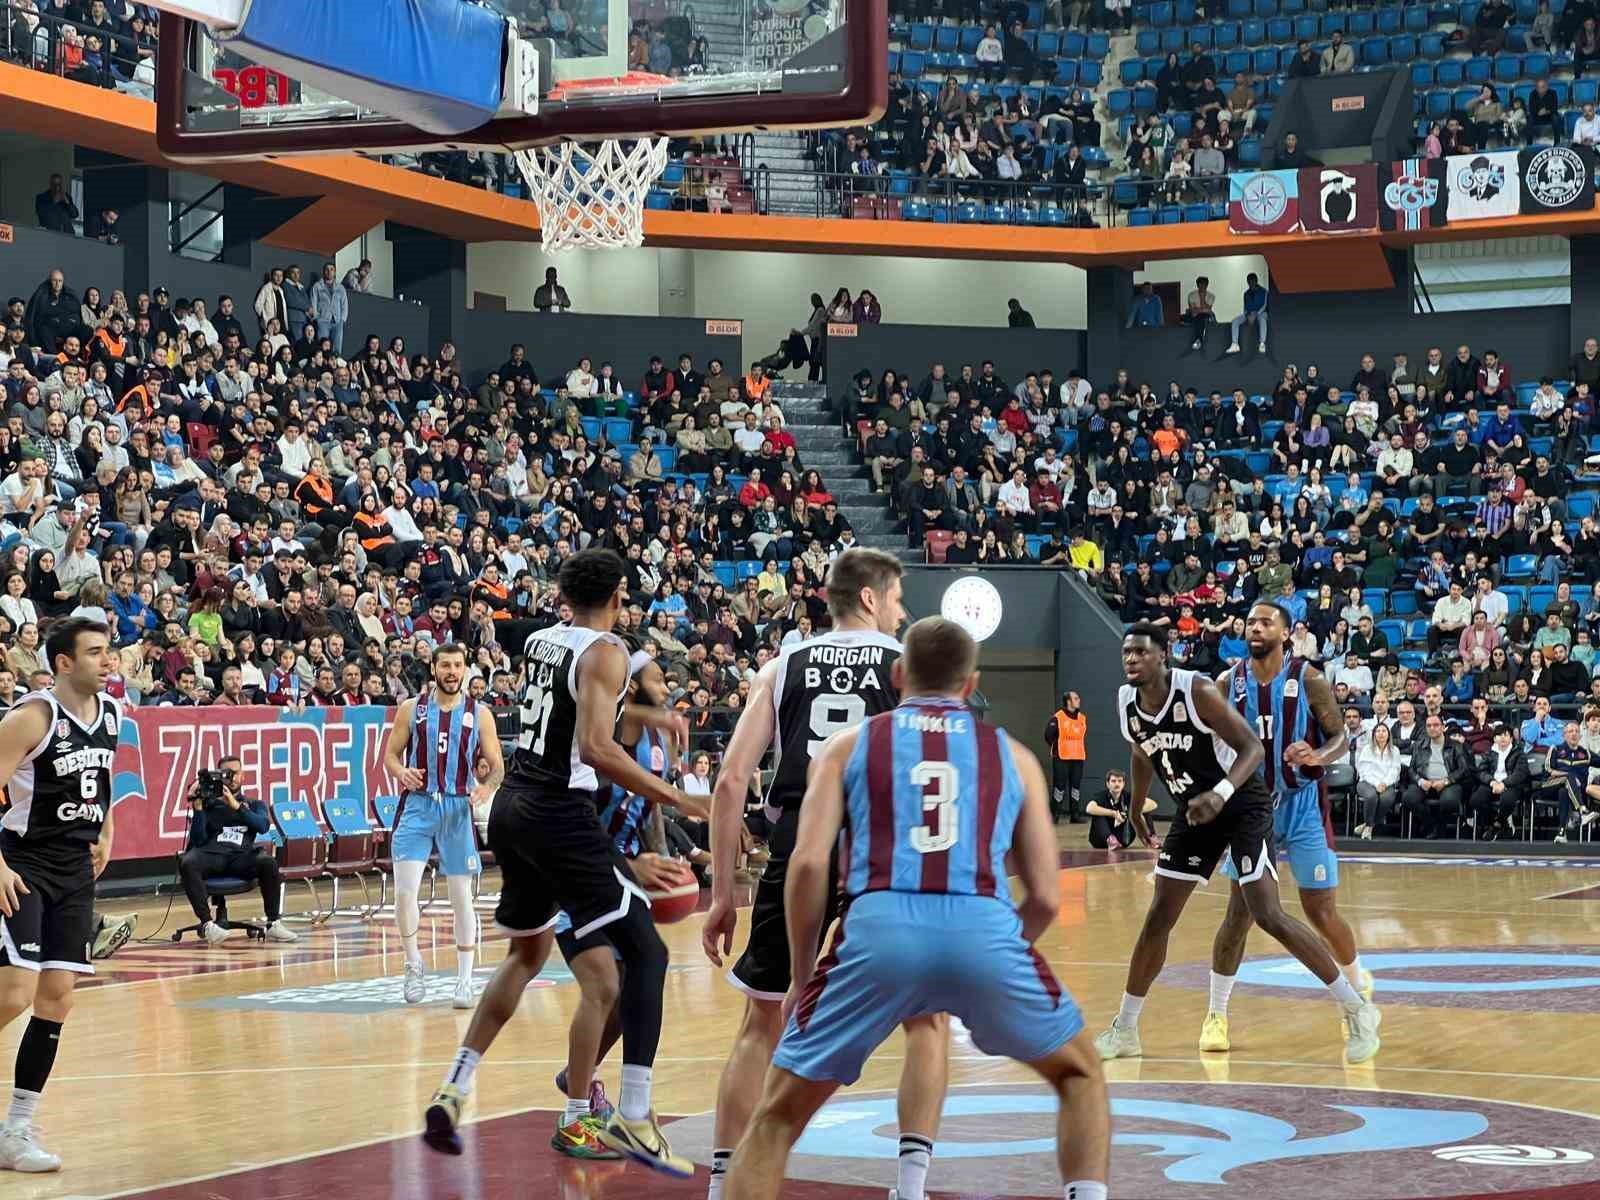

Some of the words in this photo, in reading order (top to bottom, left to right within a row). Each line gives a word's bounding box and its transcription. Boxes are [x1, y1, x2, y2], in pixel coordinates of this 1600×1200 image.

[809, 647, 883, 666] MORGAN
[438, 732, 448, 753] 5
[519, 684, 554, 758] 21
[807, 693, 866, 759] 9
[81, 769, 98, 799] 6
[910, 761, 960, 854] 3
